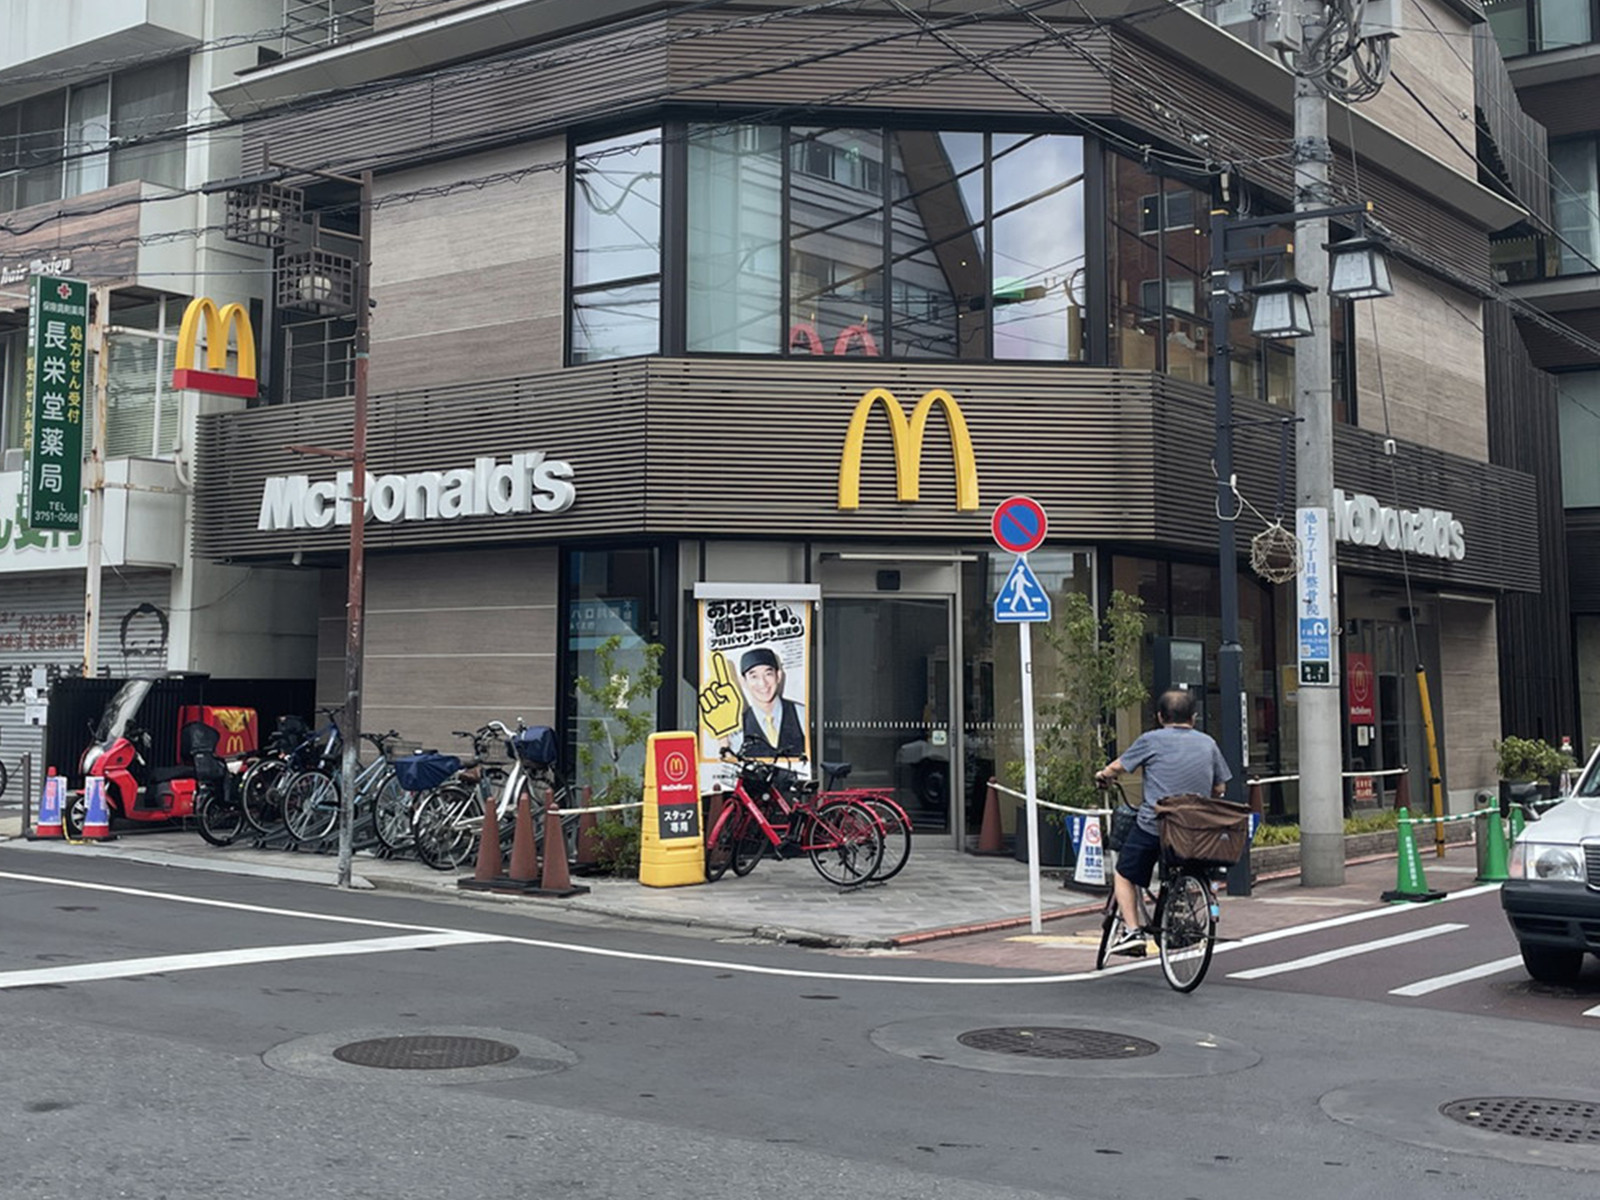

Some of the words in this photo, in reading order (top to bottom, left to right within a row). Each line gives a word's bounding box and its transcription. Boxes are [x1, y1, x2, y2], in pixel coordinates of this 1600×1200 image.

[67, 325, 83, 424] 処方せん受付
[39, 320, 67, 493] 長栄堂薬局
[49, 501, 65, 511] TEL
[258, 452, 577, 531] McDonald's
[34, 511, 78, 523] 3751-0568
[664, 810, 694, 822] スタッフ
